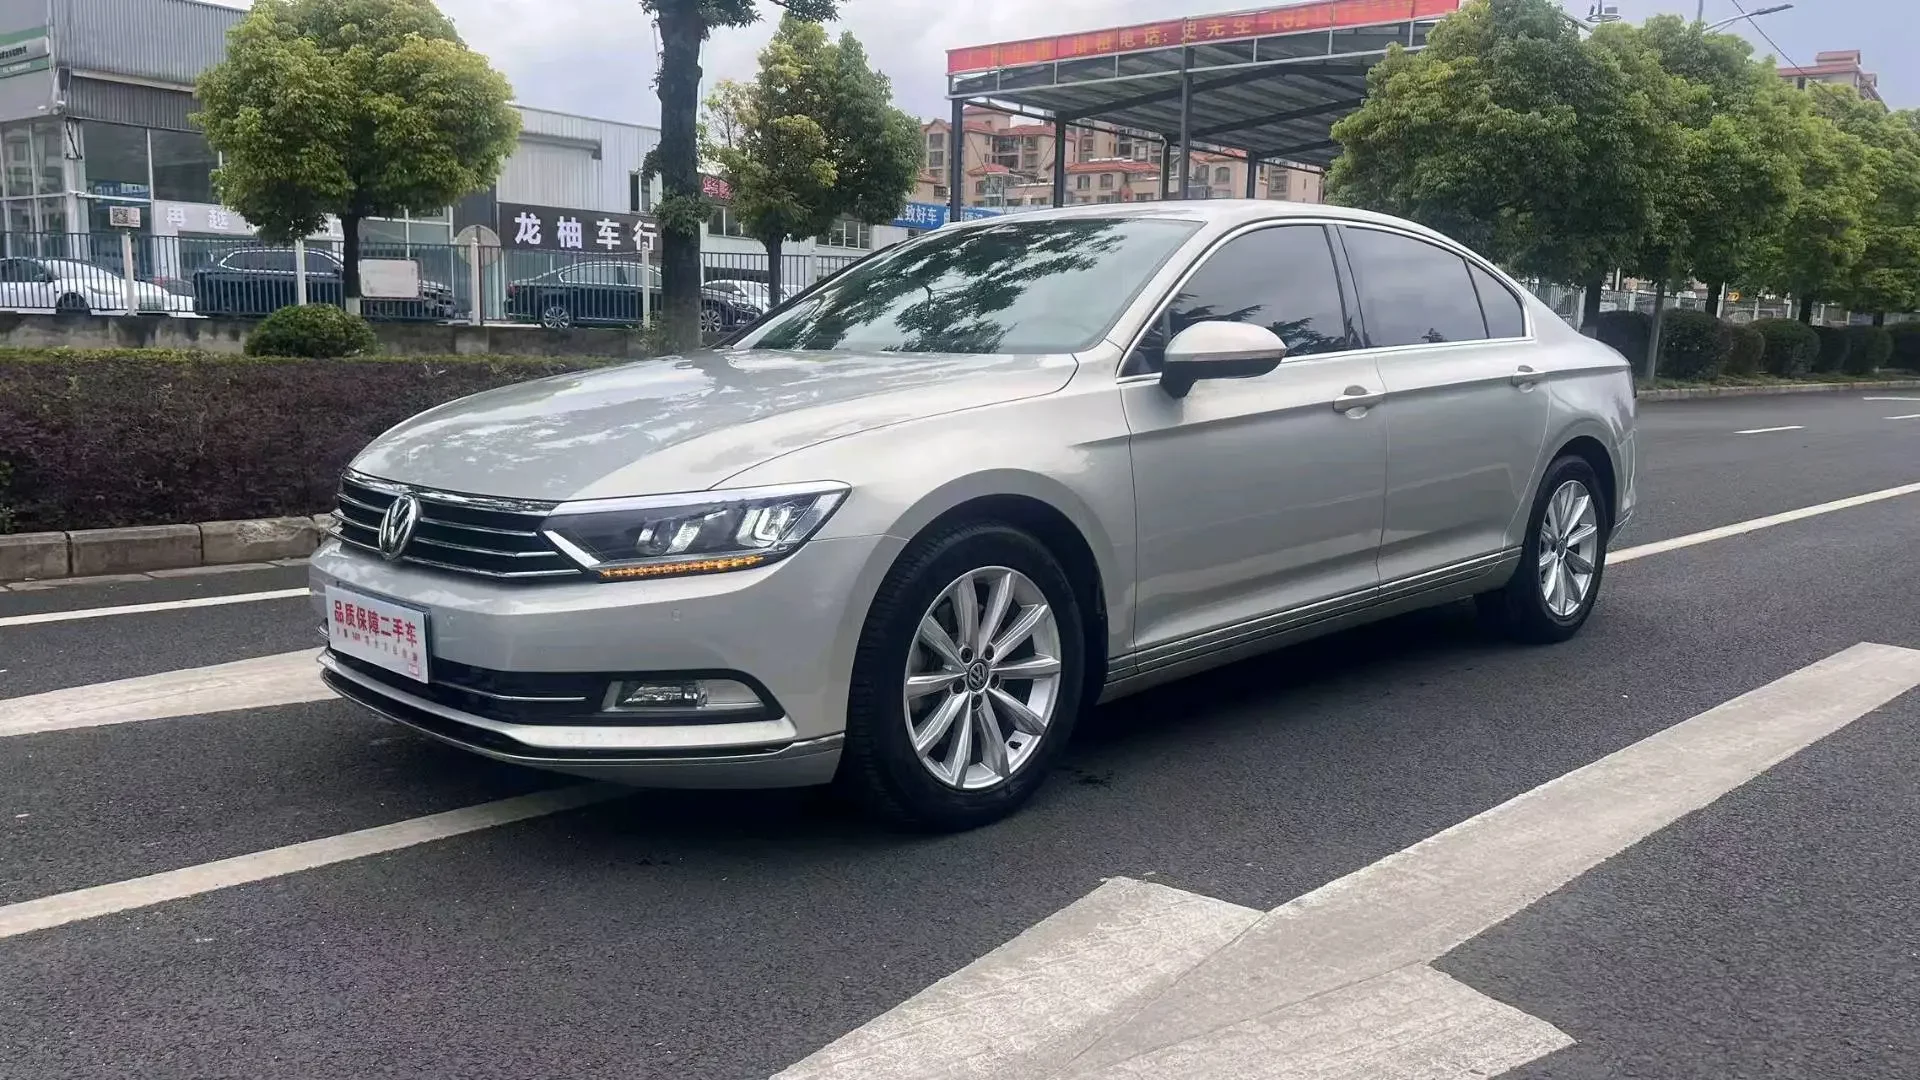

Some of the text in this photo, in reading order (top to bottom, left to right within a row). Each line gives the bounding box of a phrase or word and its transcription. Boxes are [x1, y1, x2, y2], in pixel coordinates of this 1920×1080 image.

[514, 212, 658, 251] 龙柚车行
[894, 204, 938, 225] 致好车
[334, 599, 418, 649] 品质保障二手车
